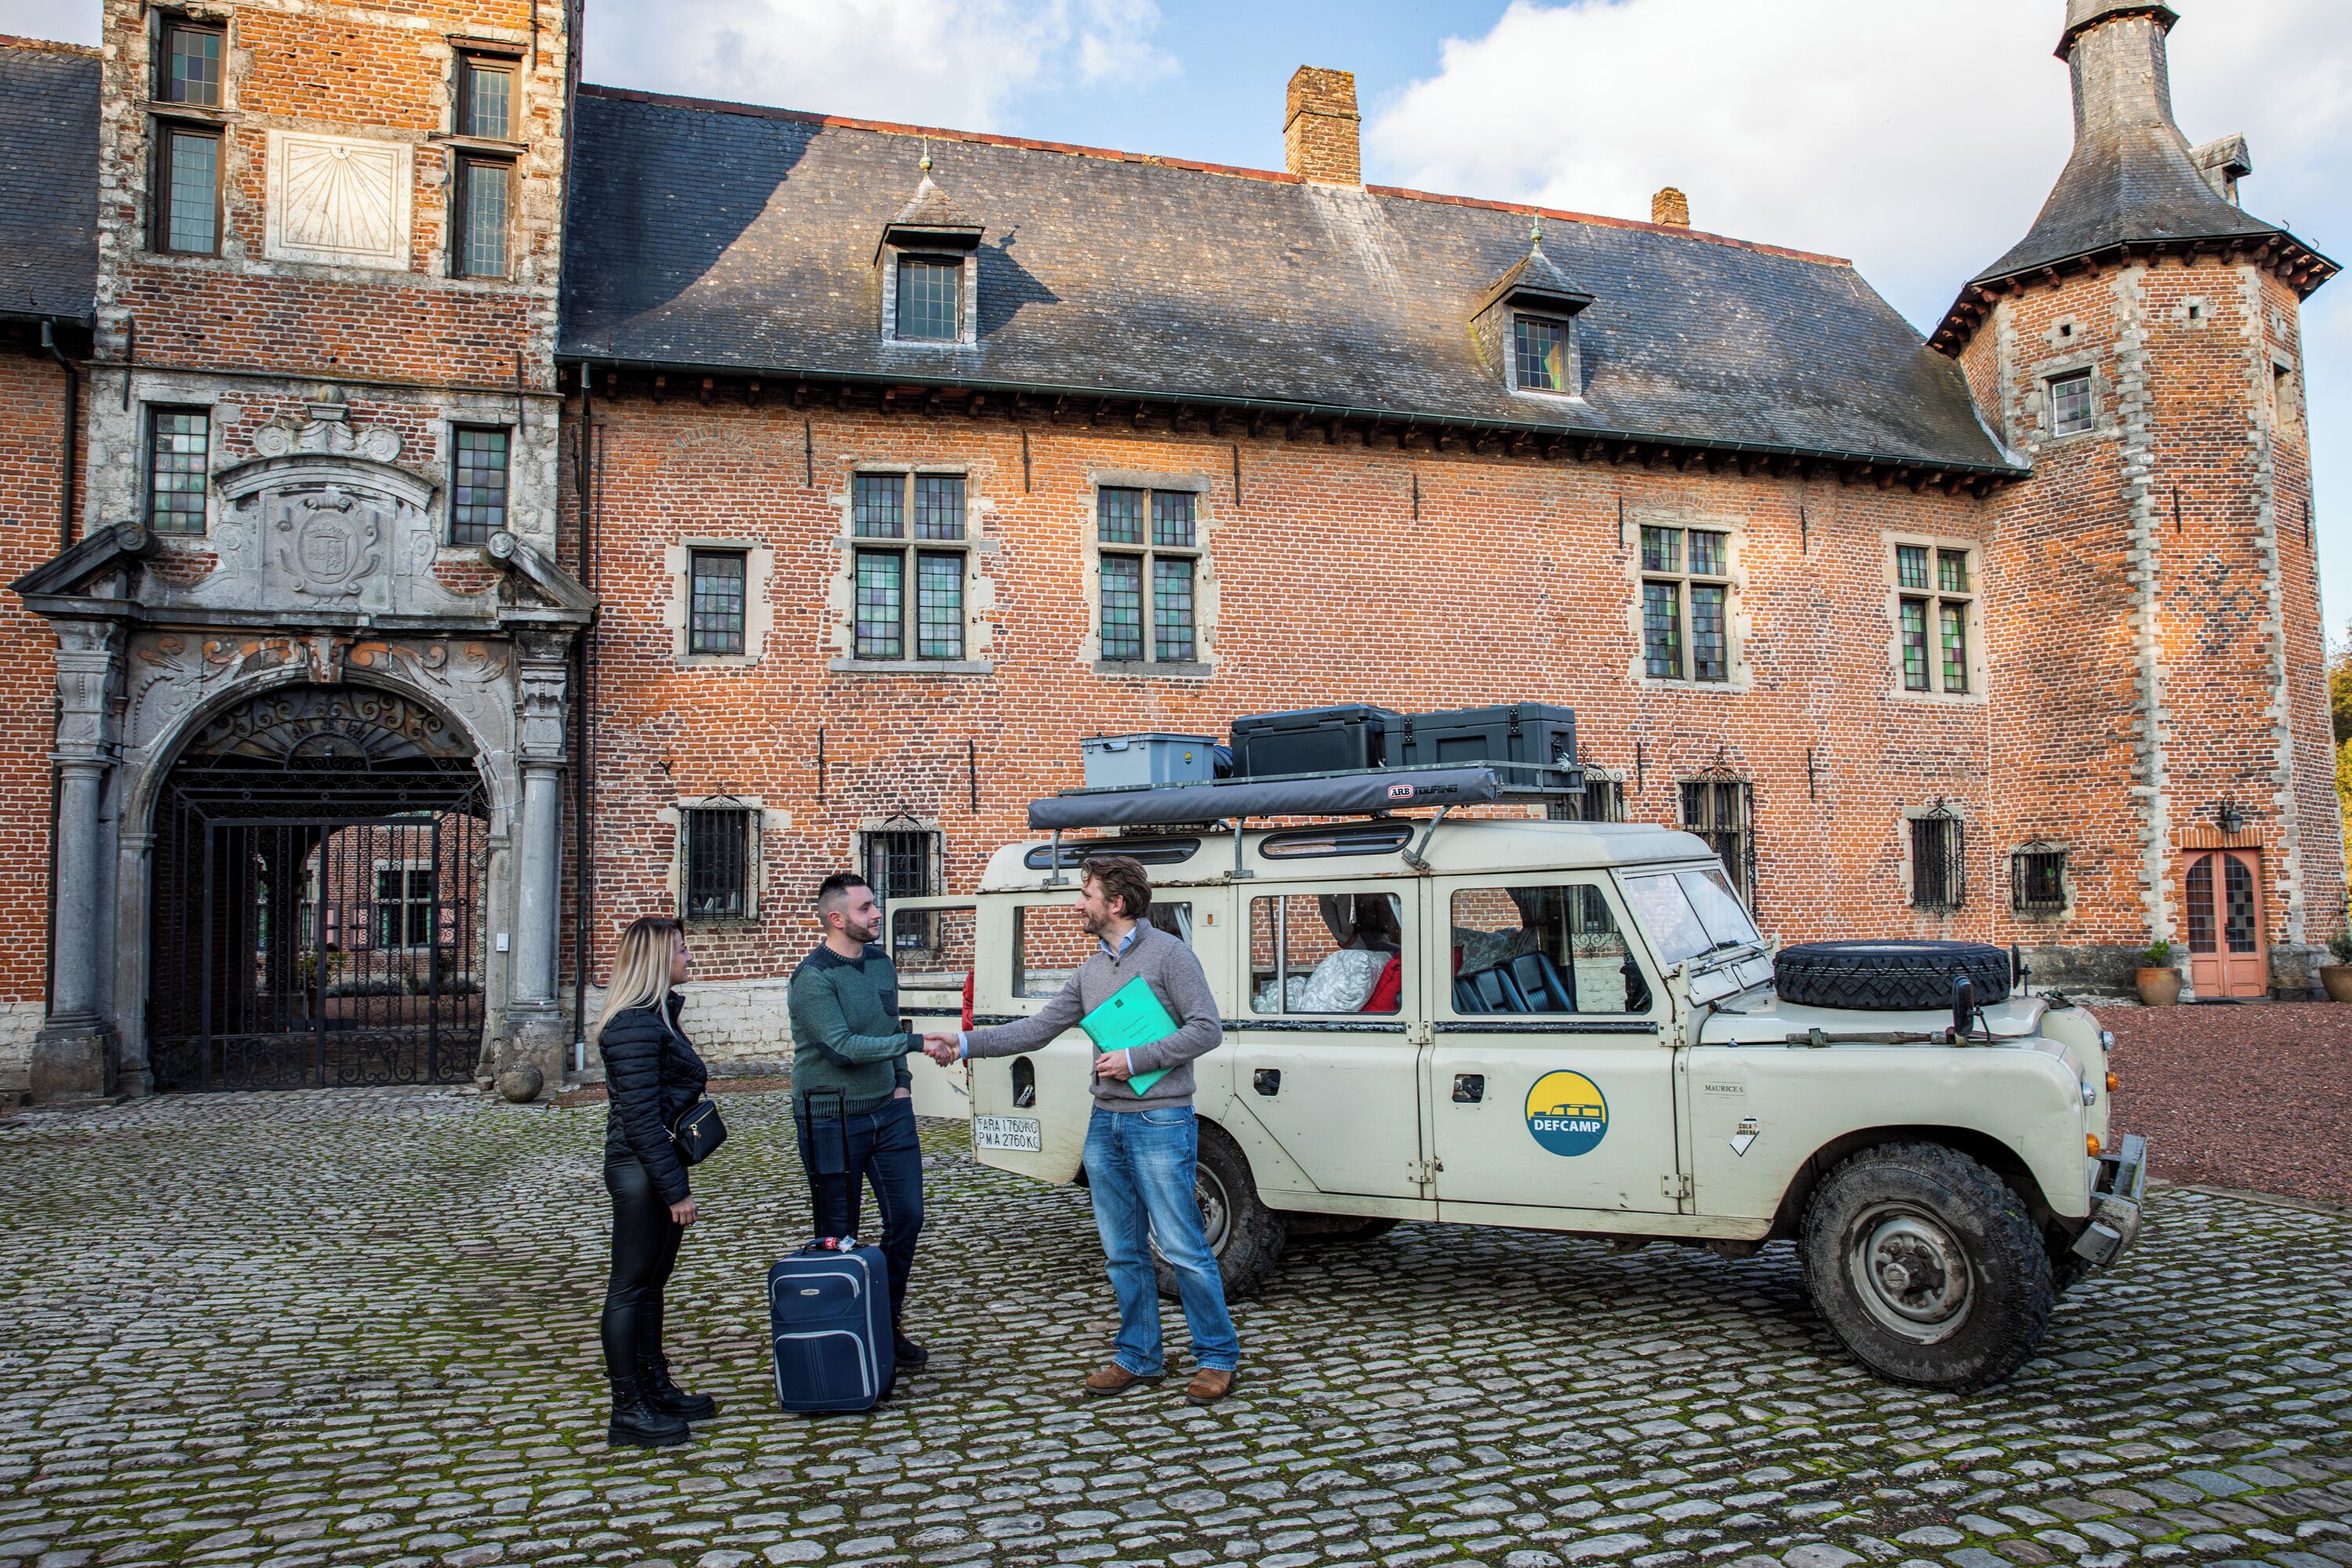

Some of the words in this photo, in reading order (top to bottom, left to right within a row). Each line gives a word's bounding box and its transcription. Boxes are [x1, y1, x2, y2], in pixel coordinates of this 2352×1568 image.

[1414, 784, 1458, 795] TOURING
[977, 1118, 1000, 1131] TARA
[1534, 1120, 1601, 1133] DEFCAMP
